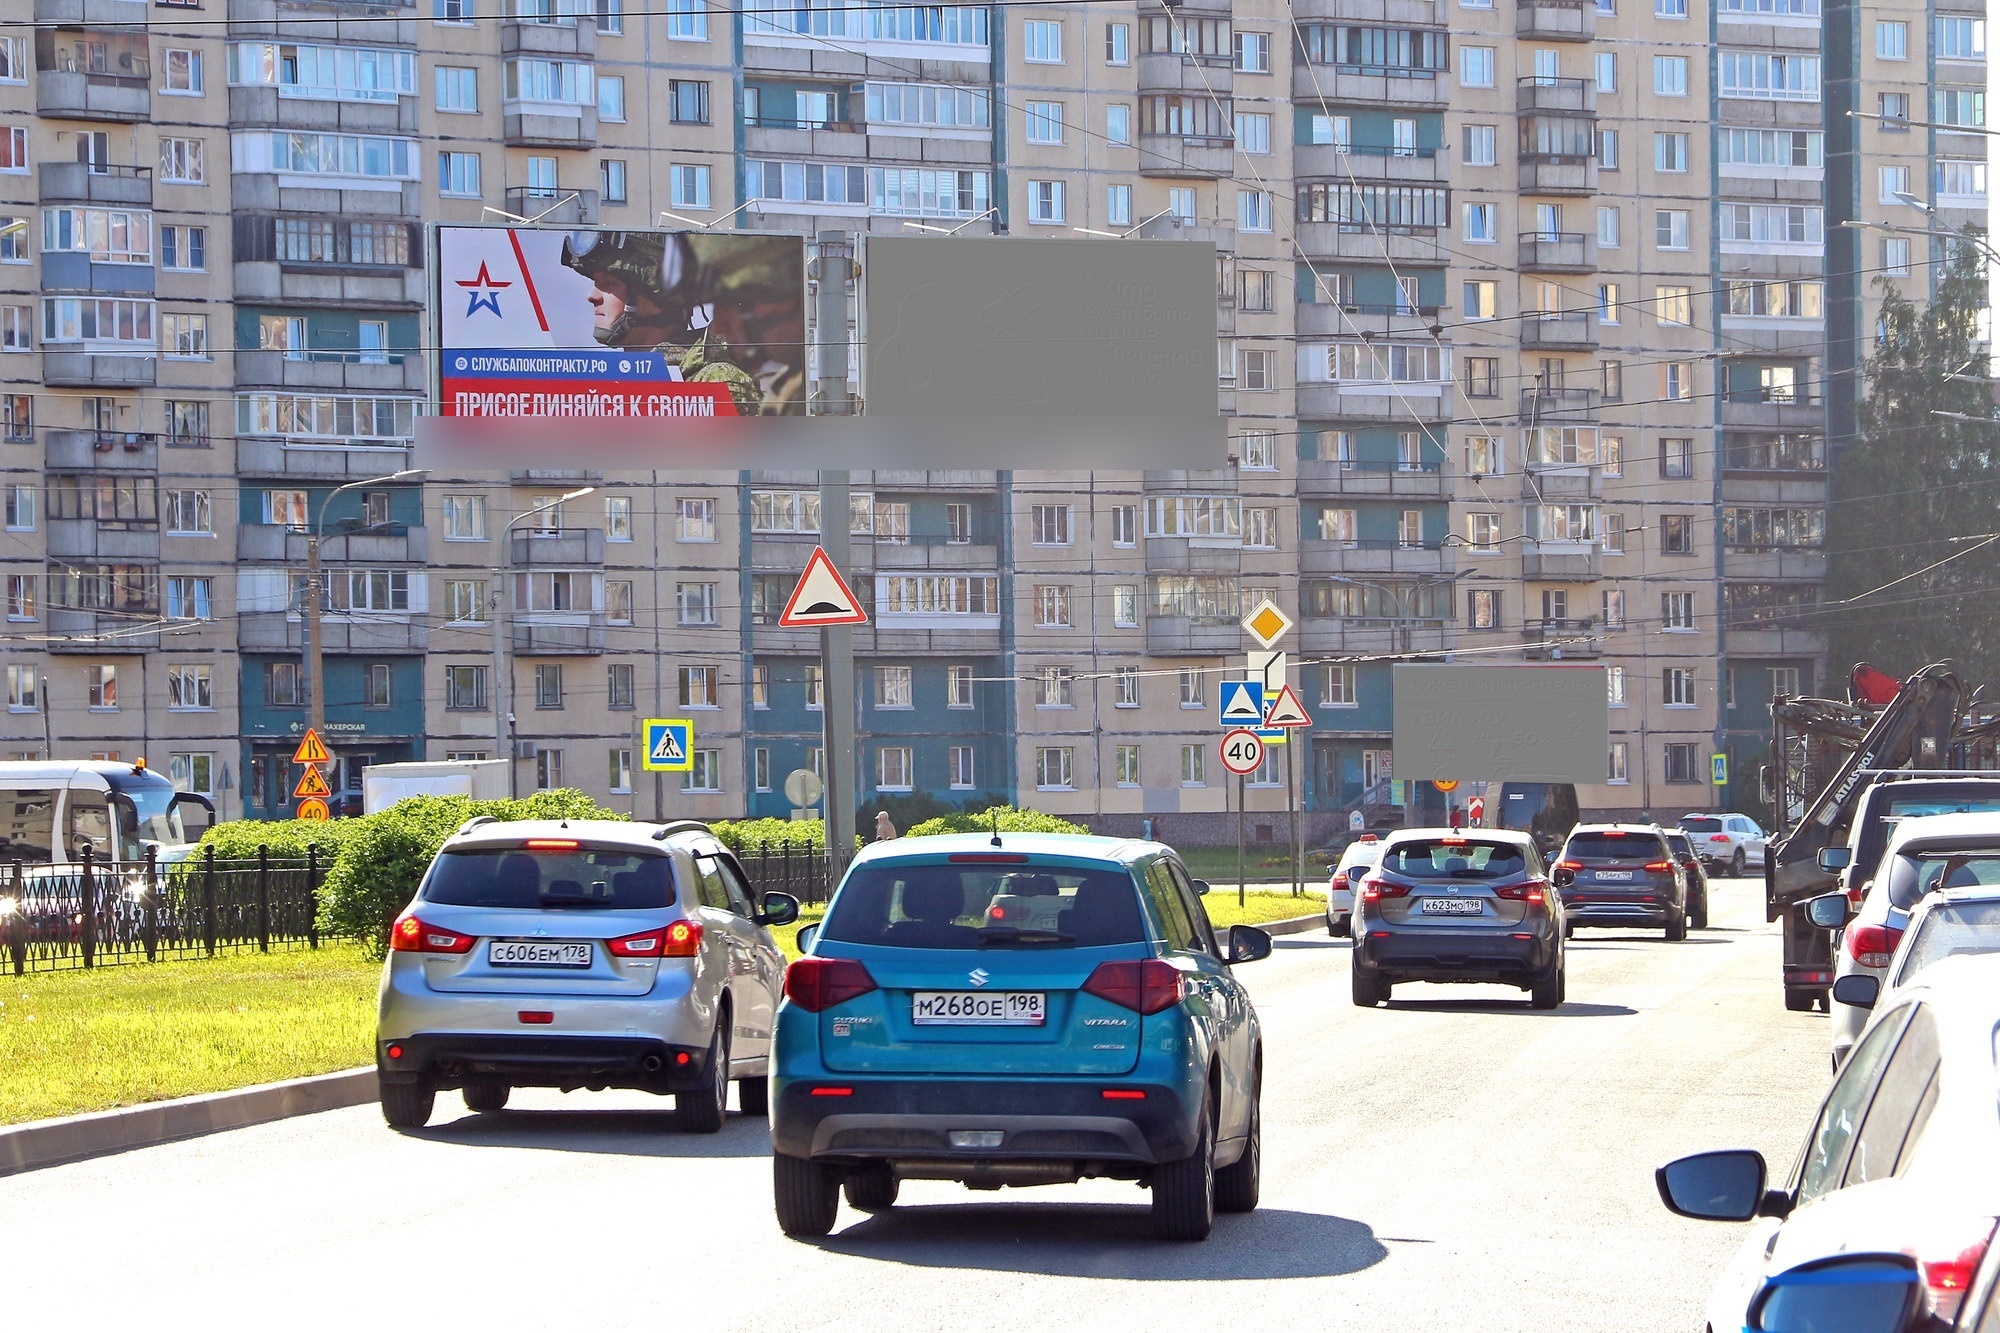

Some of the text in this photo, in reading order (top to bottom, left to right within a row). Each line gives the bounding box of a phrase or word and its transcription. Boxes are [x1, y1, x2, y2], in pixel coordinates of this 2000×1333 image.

[471, 357, 652, 374] СЛУЖБАПОКОНТРАКТУ.РФ 117
[455, 389, 714, 417] ПРИСОЕДИНЯЙСЯ К СВОИМ
[1227, 742, 1257, 761] 40
[1834, 770, 1860, 804] ATLAS
[304, 808, 322, 820] 40
[1425, 900, 1480, 910] К623МО 198
[494, 944, 586, 962] С606ЕМ 178
[919, 994, 1039, 1016] М268ОЕ 198
[833, 1016, 873, 1024] SUZUKI
[1083, 1018, 1127, 1026] VITARA
